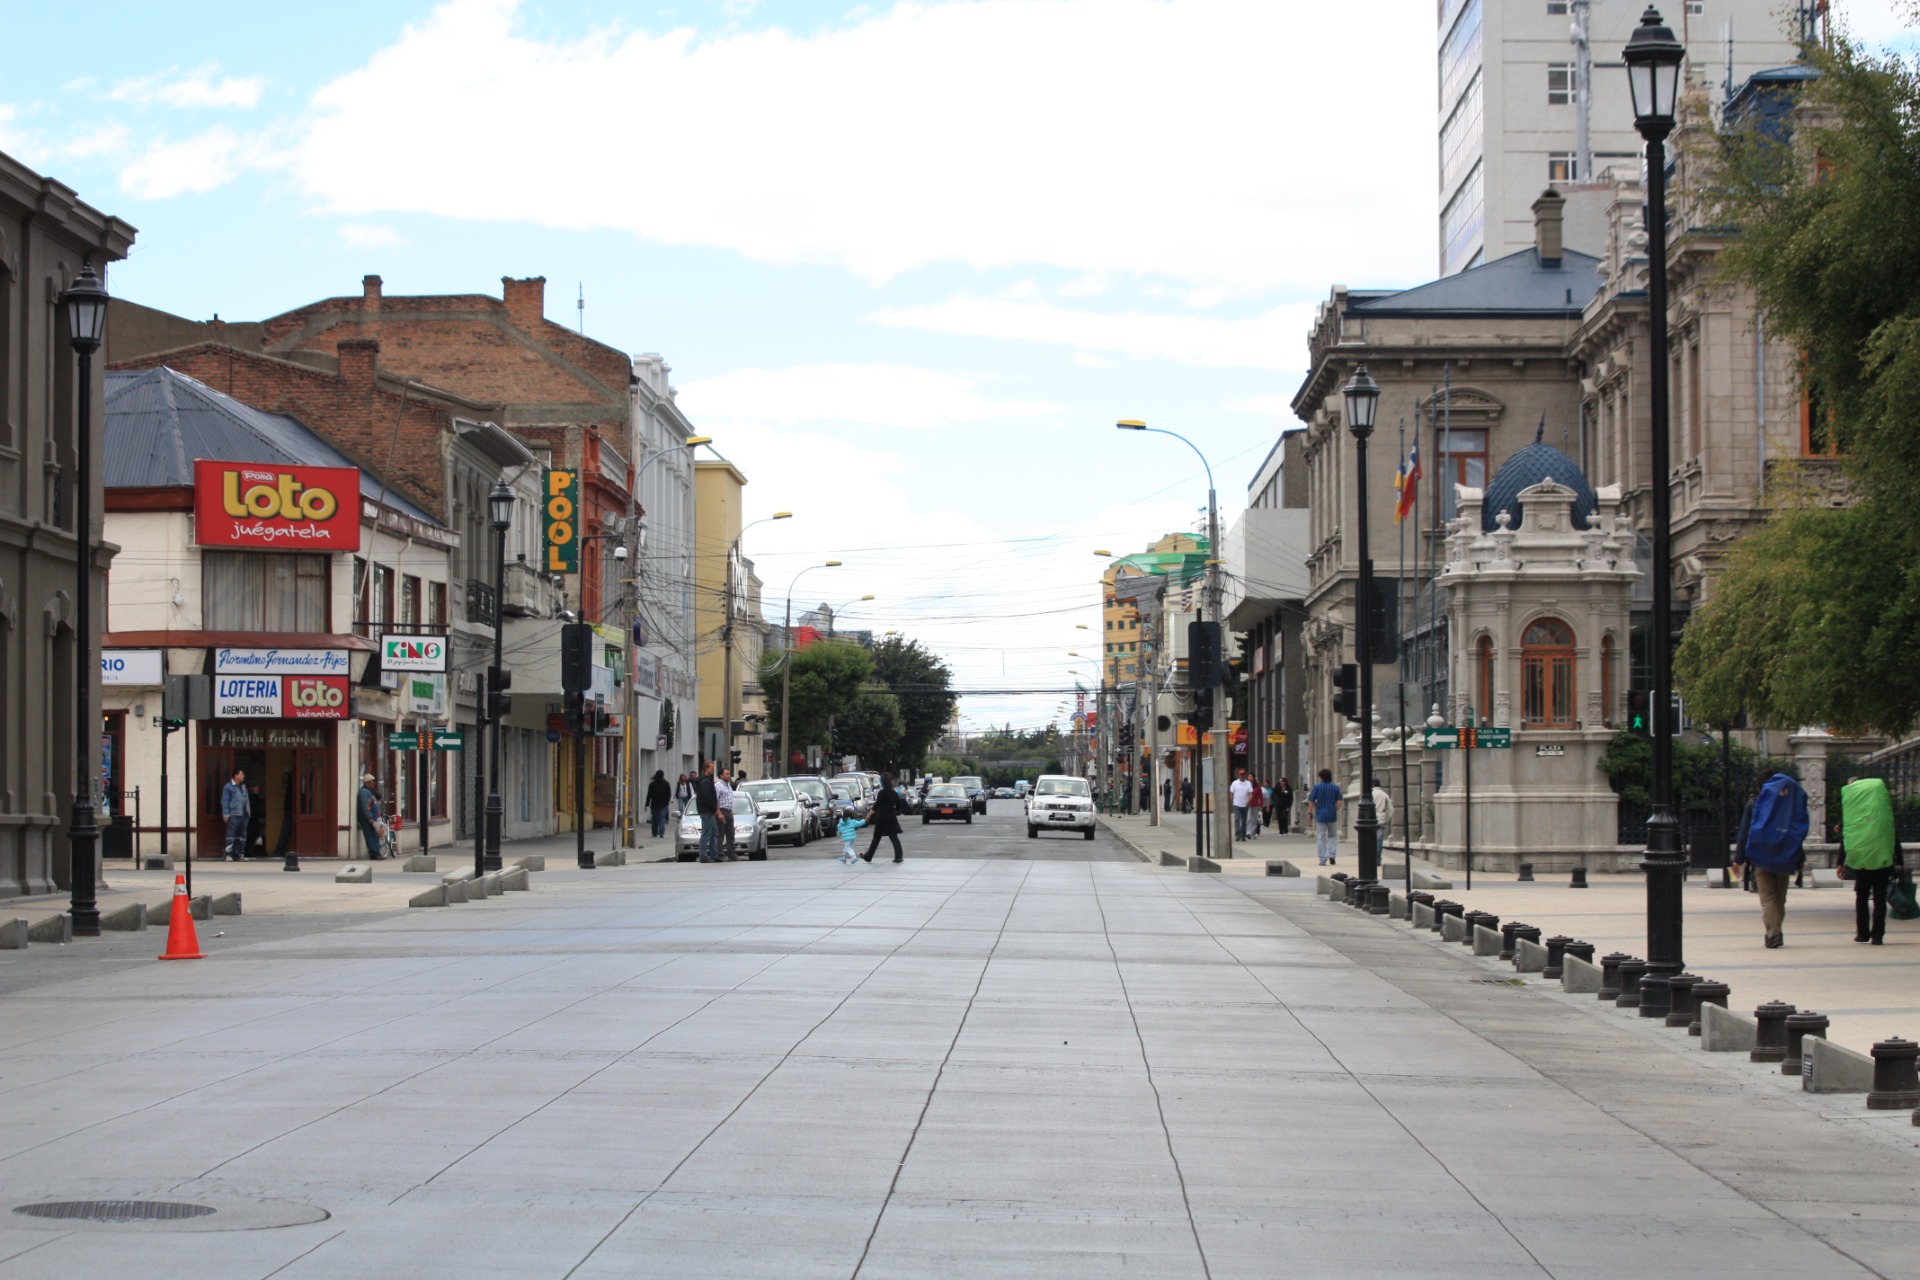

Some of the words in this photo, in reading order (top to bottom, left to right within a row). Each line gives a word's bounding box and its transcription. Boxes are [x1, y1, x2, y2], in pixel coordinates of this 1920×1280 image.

[243, 471, 275, 481] Polla
[547, 470, 573, 571] POOL
[231, 521, 331, 541] juégatela
[218, 648, 266, 669] Florentino
[220, 680, 278, 698] LOTERIA
[221, 705, 249, 715] AGENCIA
[250, 705, 275, 715] OFICIAL
